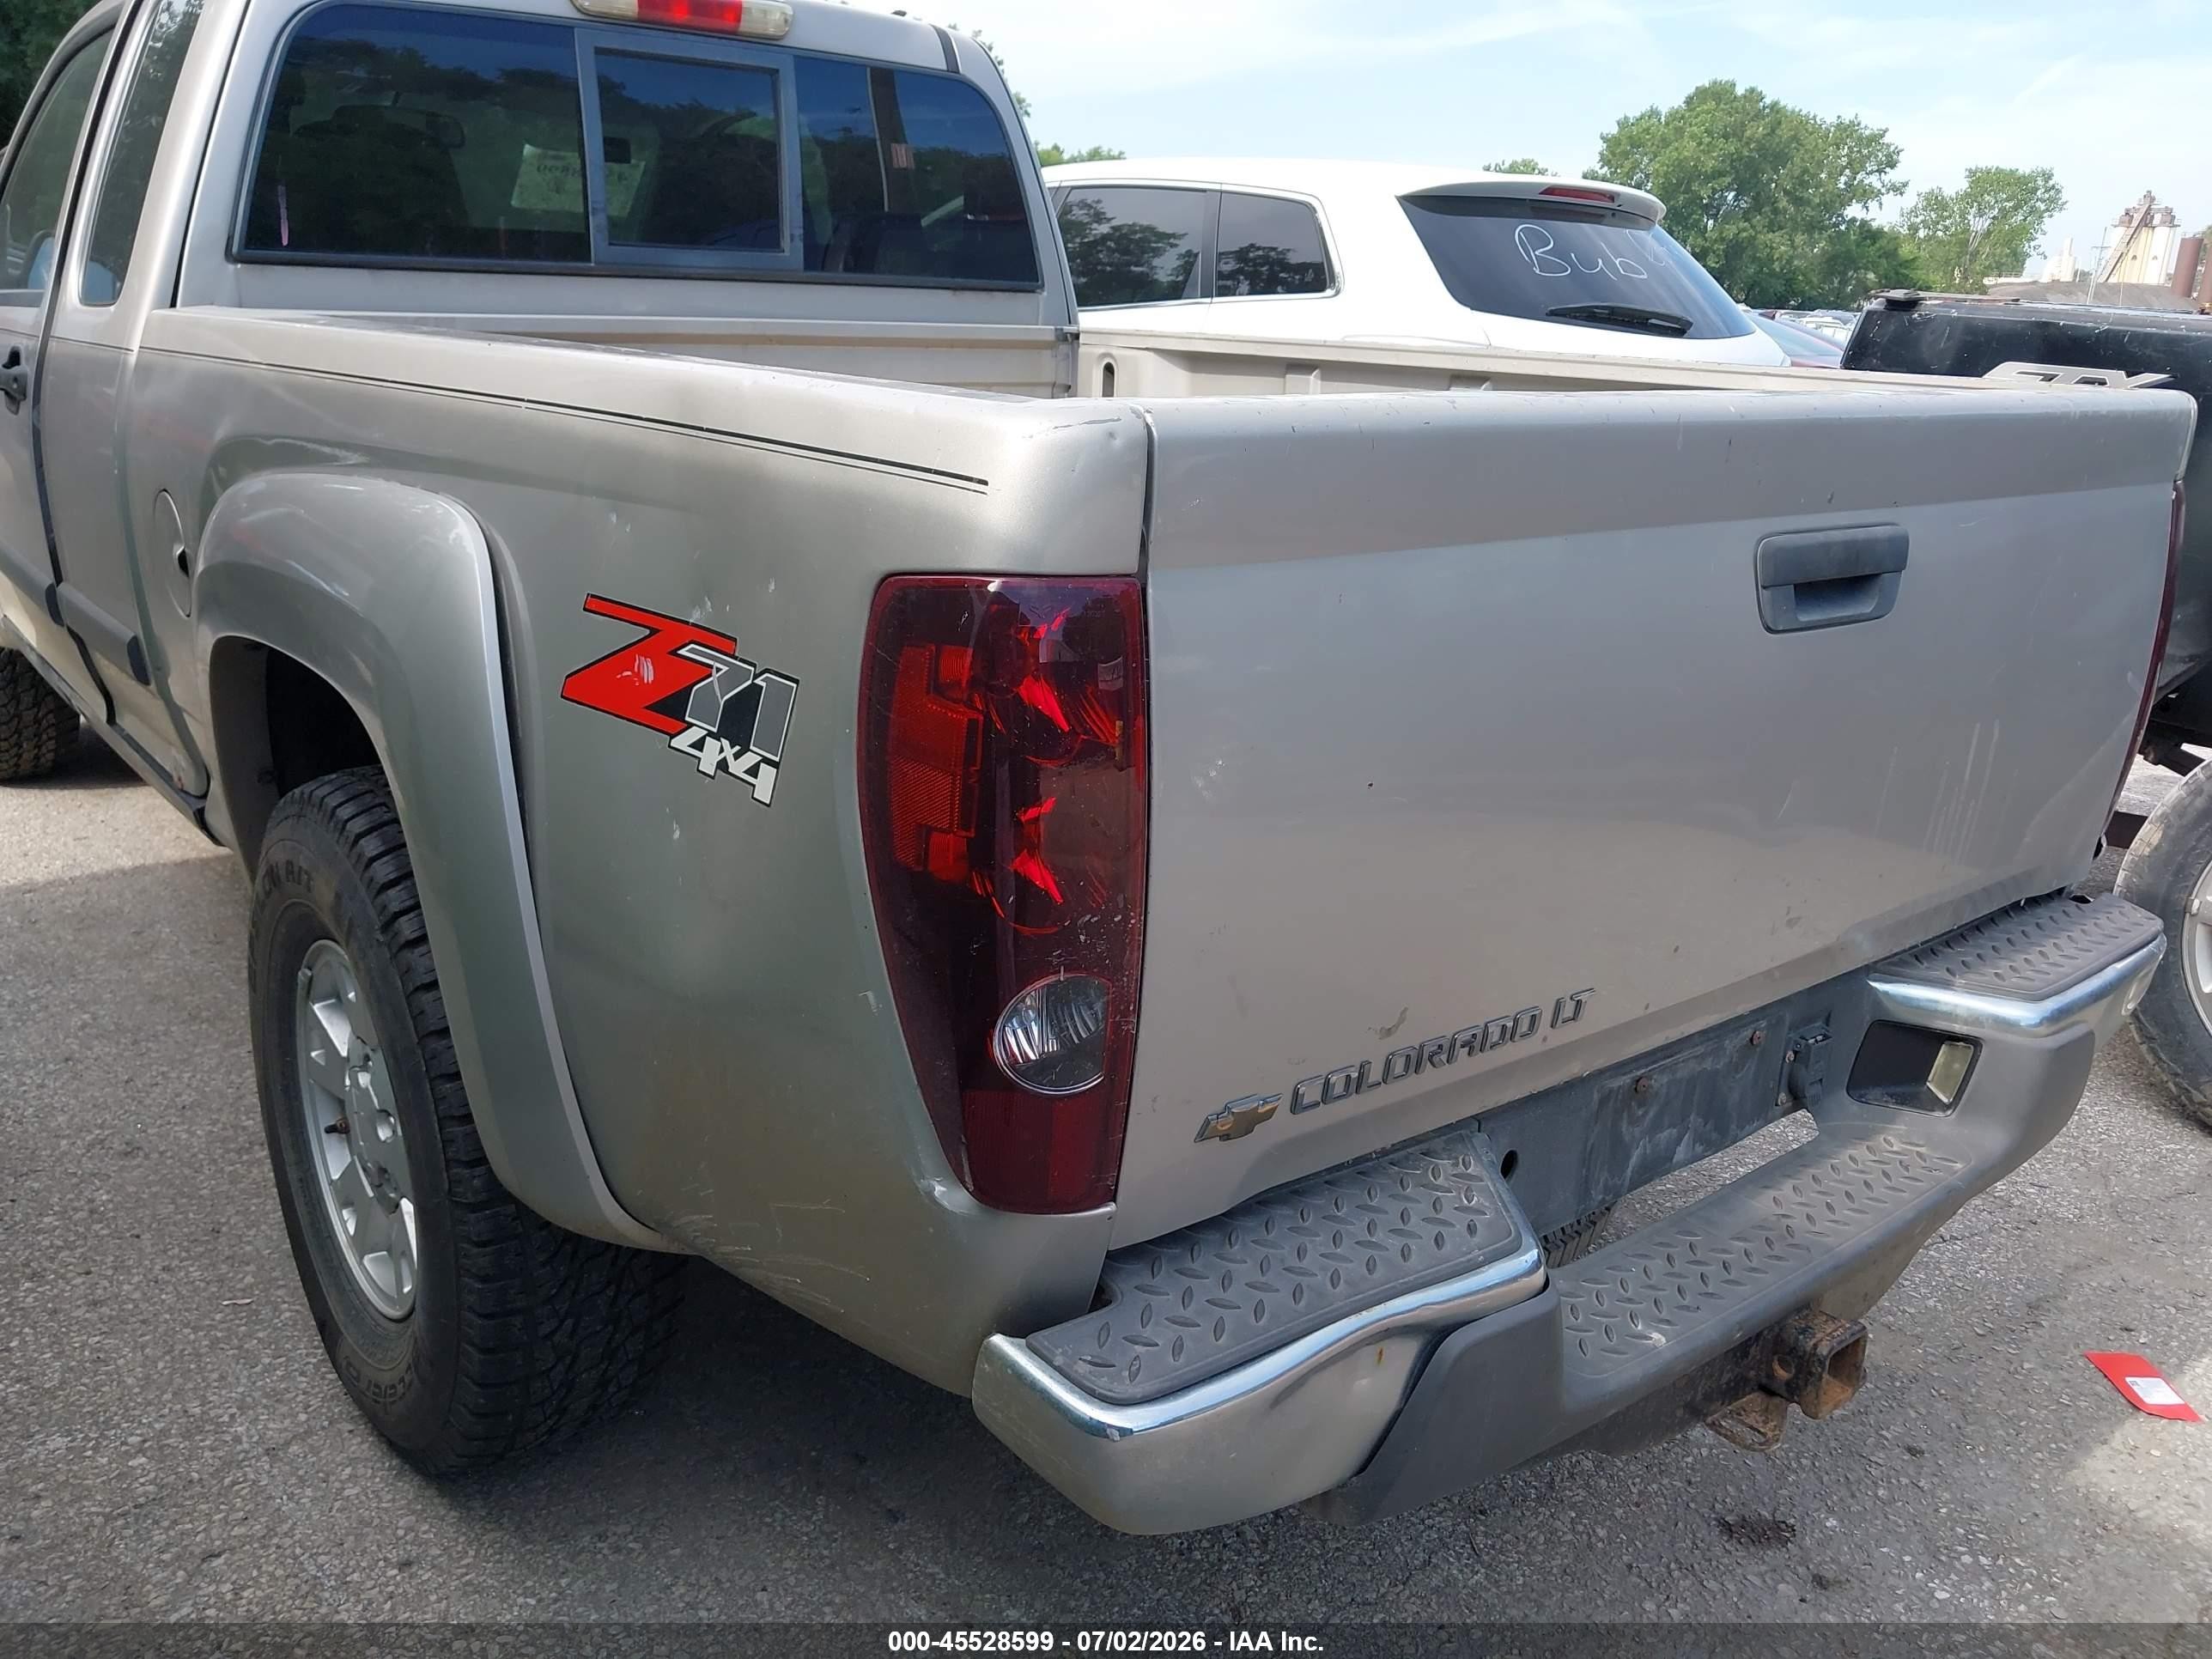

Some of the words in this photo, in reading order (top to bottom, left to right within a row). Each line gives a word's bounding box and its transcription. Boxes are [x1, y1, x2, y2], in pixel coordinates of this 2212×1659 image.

[561, 592, 799, 763] Z71
[1290, 1006, 1543, 1115] COLORADO
[1550, 988, 1595, 1030] LT
